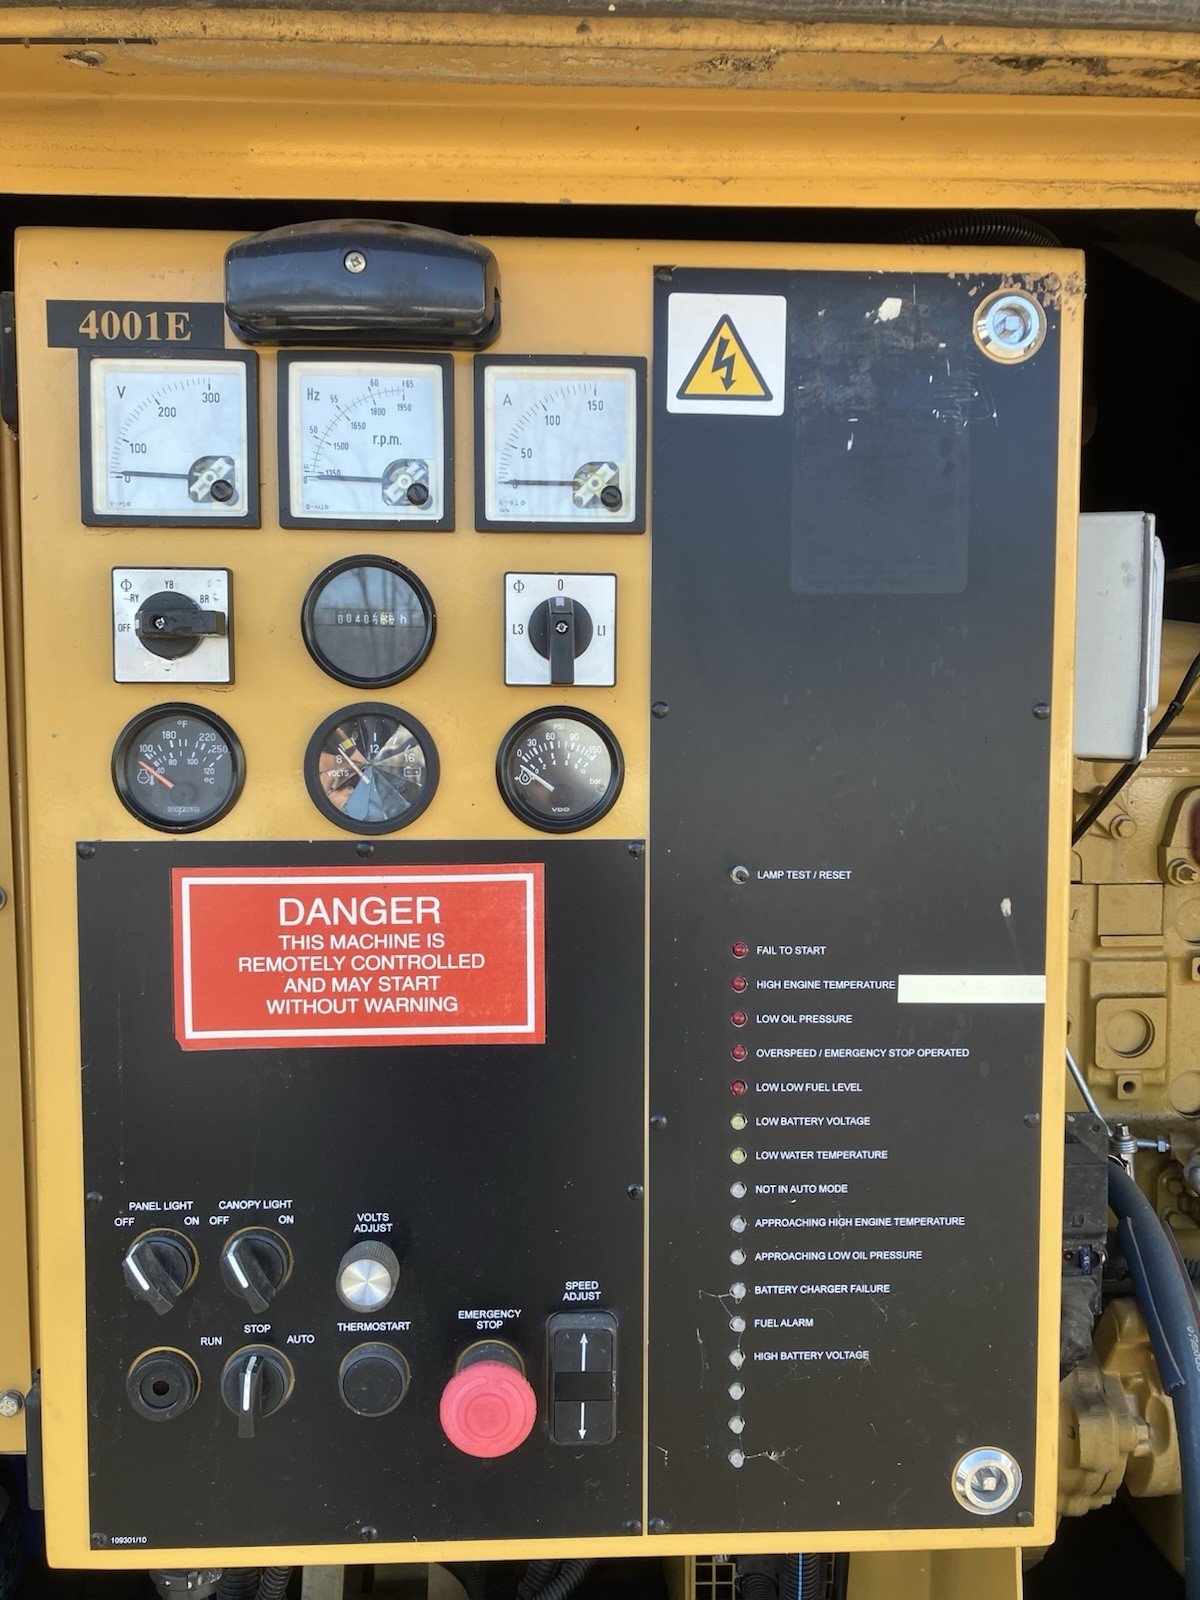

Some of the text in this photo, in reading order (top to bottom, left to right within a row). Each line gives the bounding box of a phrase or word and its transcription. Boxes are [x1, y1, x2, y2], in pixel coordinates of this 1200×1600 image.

[78, 309, 192, 341] 4001E
[370, 379, 379, 387] 60
[406, 380, 414, 388] 65
[117, 386, 126, 398] V
[307, 388, 320, 401] Hz
[202, 392, 220, 403] 300
[330, 395, 338, 403] 55
[503, 393, 512, 406] A
[397, 404, 412, 412] 1950
[588, 400, 604, 411] 150
[158, 407, 176, 417] 200
[371, 408, 386, 416] 1800
[545, 415, 560, 426] 100
[310, 426, 318, 434] 50
[351, 422, 366, 430] 1650
[373, 434, 402, 447] r.p.m.
[130, 443, 147, 454] 100
[334, 442, 349, 450] 1500
[521, 448, 532, 458] 50
[165, 580, 174, 589] YB
[130, 594, 139, 603] RY
[200, 595, 209, 603] BR
[400, 614, 407, 625] h
[118, 623, 131, 632] OFF
[513, 624, 523, 634] L3
[598, 625, 606, 636] L1
[162, 730, 176, 739] 180
[199, 733, 216, 741] 220
[527, 738, 537, 746] 30
[140, 744, 153, 753] 100
[211, 745, 228, 753] 250
[370, 744, 379, 753] 12
[517, 749, 522, 757] 0
[589, 746, 601, 754] 150
[168, 758, 177, 766] 80
[336, 755, 342, 764] 8
[404, 754, 415, 763] 16
[757, 870, 784, 879] LAMP
[786, 870, 812, 879] TEST
[819, 870, 851, 879] RESET
[278, 896, 441, 926] DANGER
[278, 933, 445, 950] THIS MACHINE IS
[756, 946, 826, 955] FAIL TO START
[239, 953, 485, 972] REMOTELY CONTROLLED
[284, 976, 441, 993] AND MAY START
[756, 980, 896, 989] HIGH ENGINE TEMPERATURE
[266, 996, 458, 1014] WITHOUT WARNING
[756, 1014, 852, 1023] LOW OIL PRESSURE
[756, 1048, 817, 1058] OVERSPEED
[824, 1048, 887, 1058] EMERGENCY
[889, 1048, 915, 1057] STOP
[917, 1048, 969, 1057] OPERATED
[756, 1083, 862, 1092] LOW LOW FUEL LEVEL
[755, 1117, 871, 1126] LOW BATTERY VOLTAGE
[755, 1150, 888, 1160] LOW WATER TEMPERATURE
[755, 1184, 848, 1194] NOT IN AUTO MODE
[129, 1201, 193, 1211] PANEL LIGHT
[219, 1200, 293, 1210] CANOPY LIGHT
[114, 1217, 135, 1227] OFF
[184, 1216, 199, 1226] ON
[209, 1216, 229, 1226] OFF
[278, 1215, 294, 1225] ON
[357, 1213, 389, 1222] VOLTS
[755, 1217, 965, 1227] APPROACHING HIGH ENGINE TEMPERATURE
[354, 1223, 393, 1233] ADJUST
[755, 1251, 922, 1261] APPROACHING LOW OIL PRESSURE
[565, 1281, 598, 1290] SPEED
[755, 1285, 890, 1294] BATTERY CHARGER FAILURE
[563, 1291, 601, 1301] ADJUST
[458, 1309, 522, 1319] EMERGENCY
[244, 1324, 271, 1333] STOP
[337, 1321, 411, 1331] THERMOSTART
[476, 1320, 503, 1330] STOP
[755, 1319, 813, 1328] FUEL ALARM
[200, 1336, 222, 1346] RUN
[287, 1335, 315, 1344] AUTO
[754, 1351, 869, 1361] HIGH BATTERY VOLTAGE
